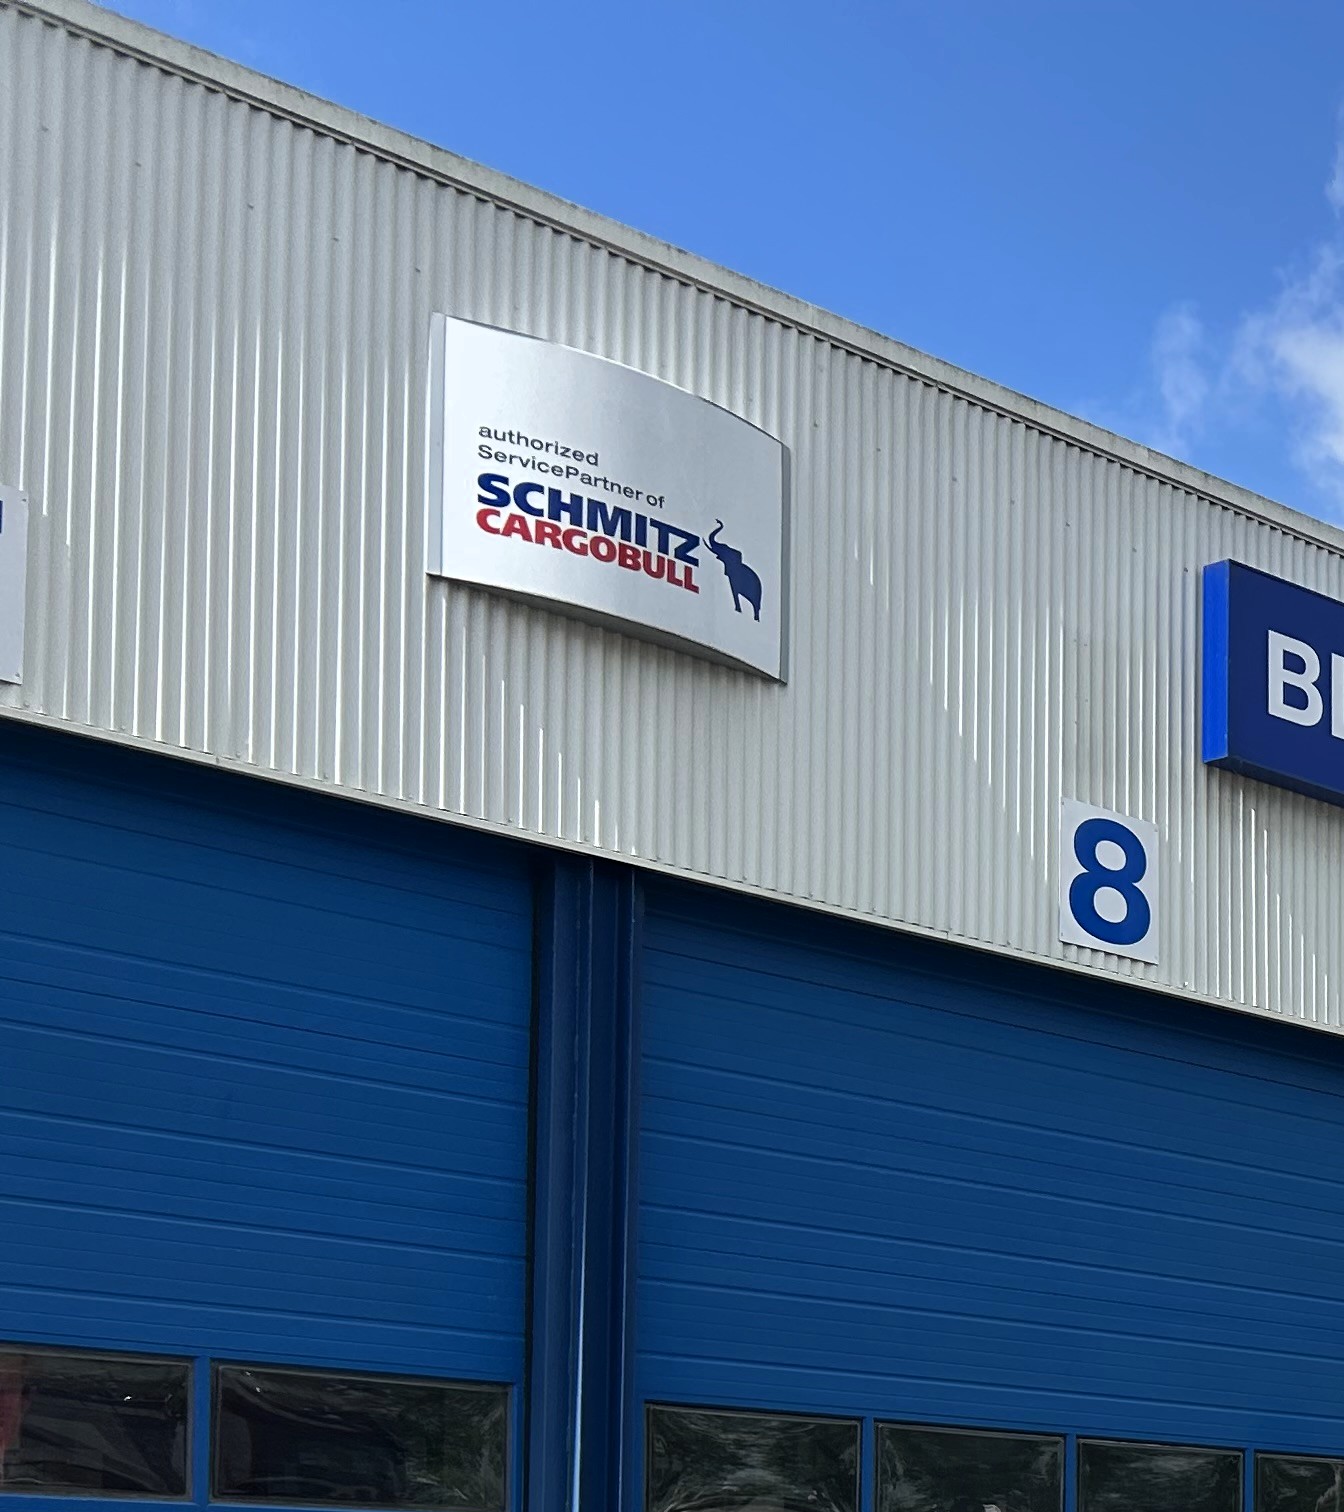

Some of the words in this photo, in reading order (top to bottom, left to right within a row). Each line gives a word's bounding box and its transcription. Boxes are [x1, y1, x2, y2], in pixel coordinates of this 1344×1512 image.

[477, 444, 644, 500] ServicePartner
[646, 495, 666, 509] of
[478, 425, 600, 466] authorized
[475, 508, 700, 594] CARGOBULL
[476, 473, 701, 567] SCHMITZ
[1068, 817, 1151, 946] 8
